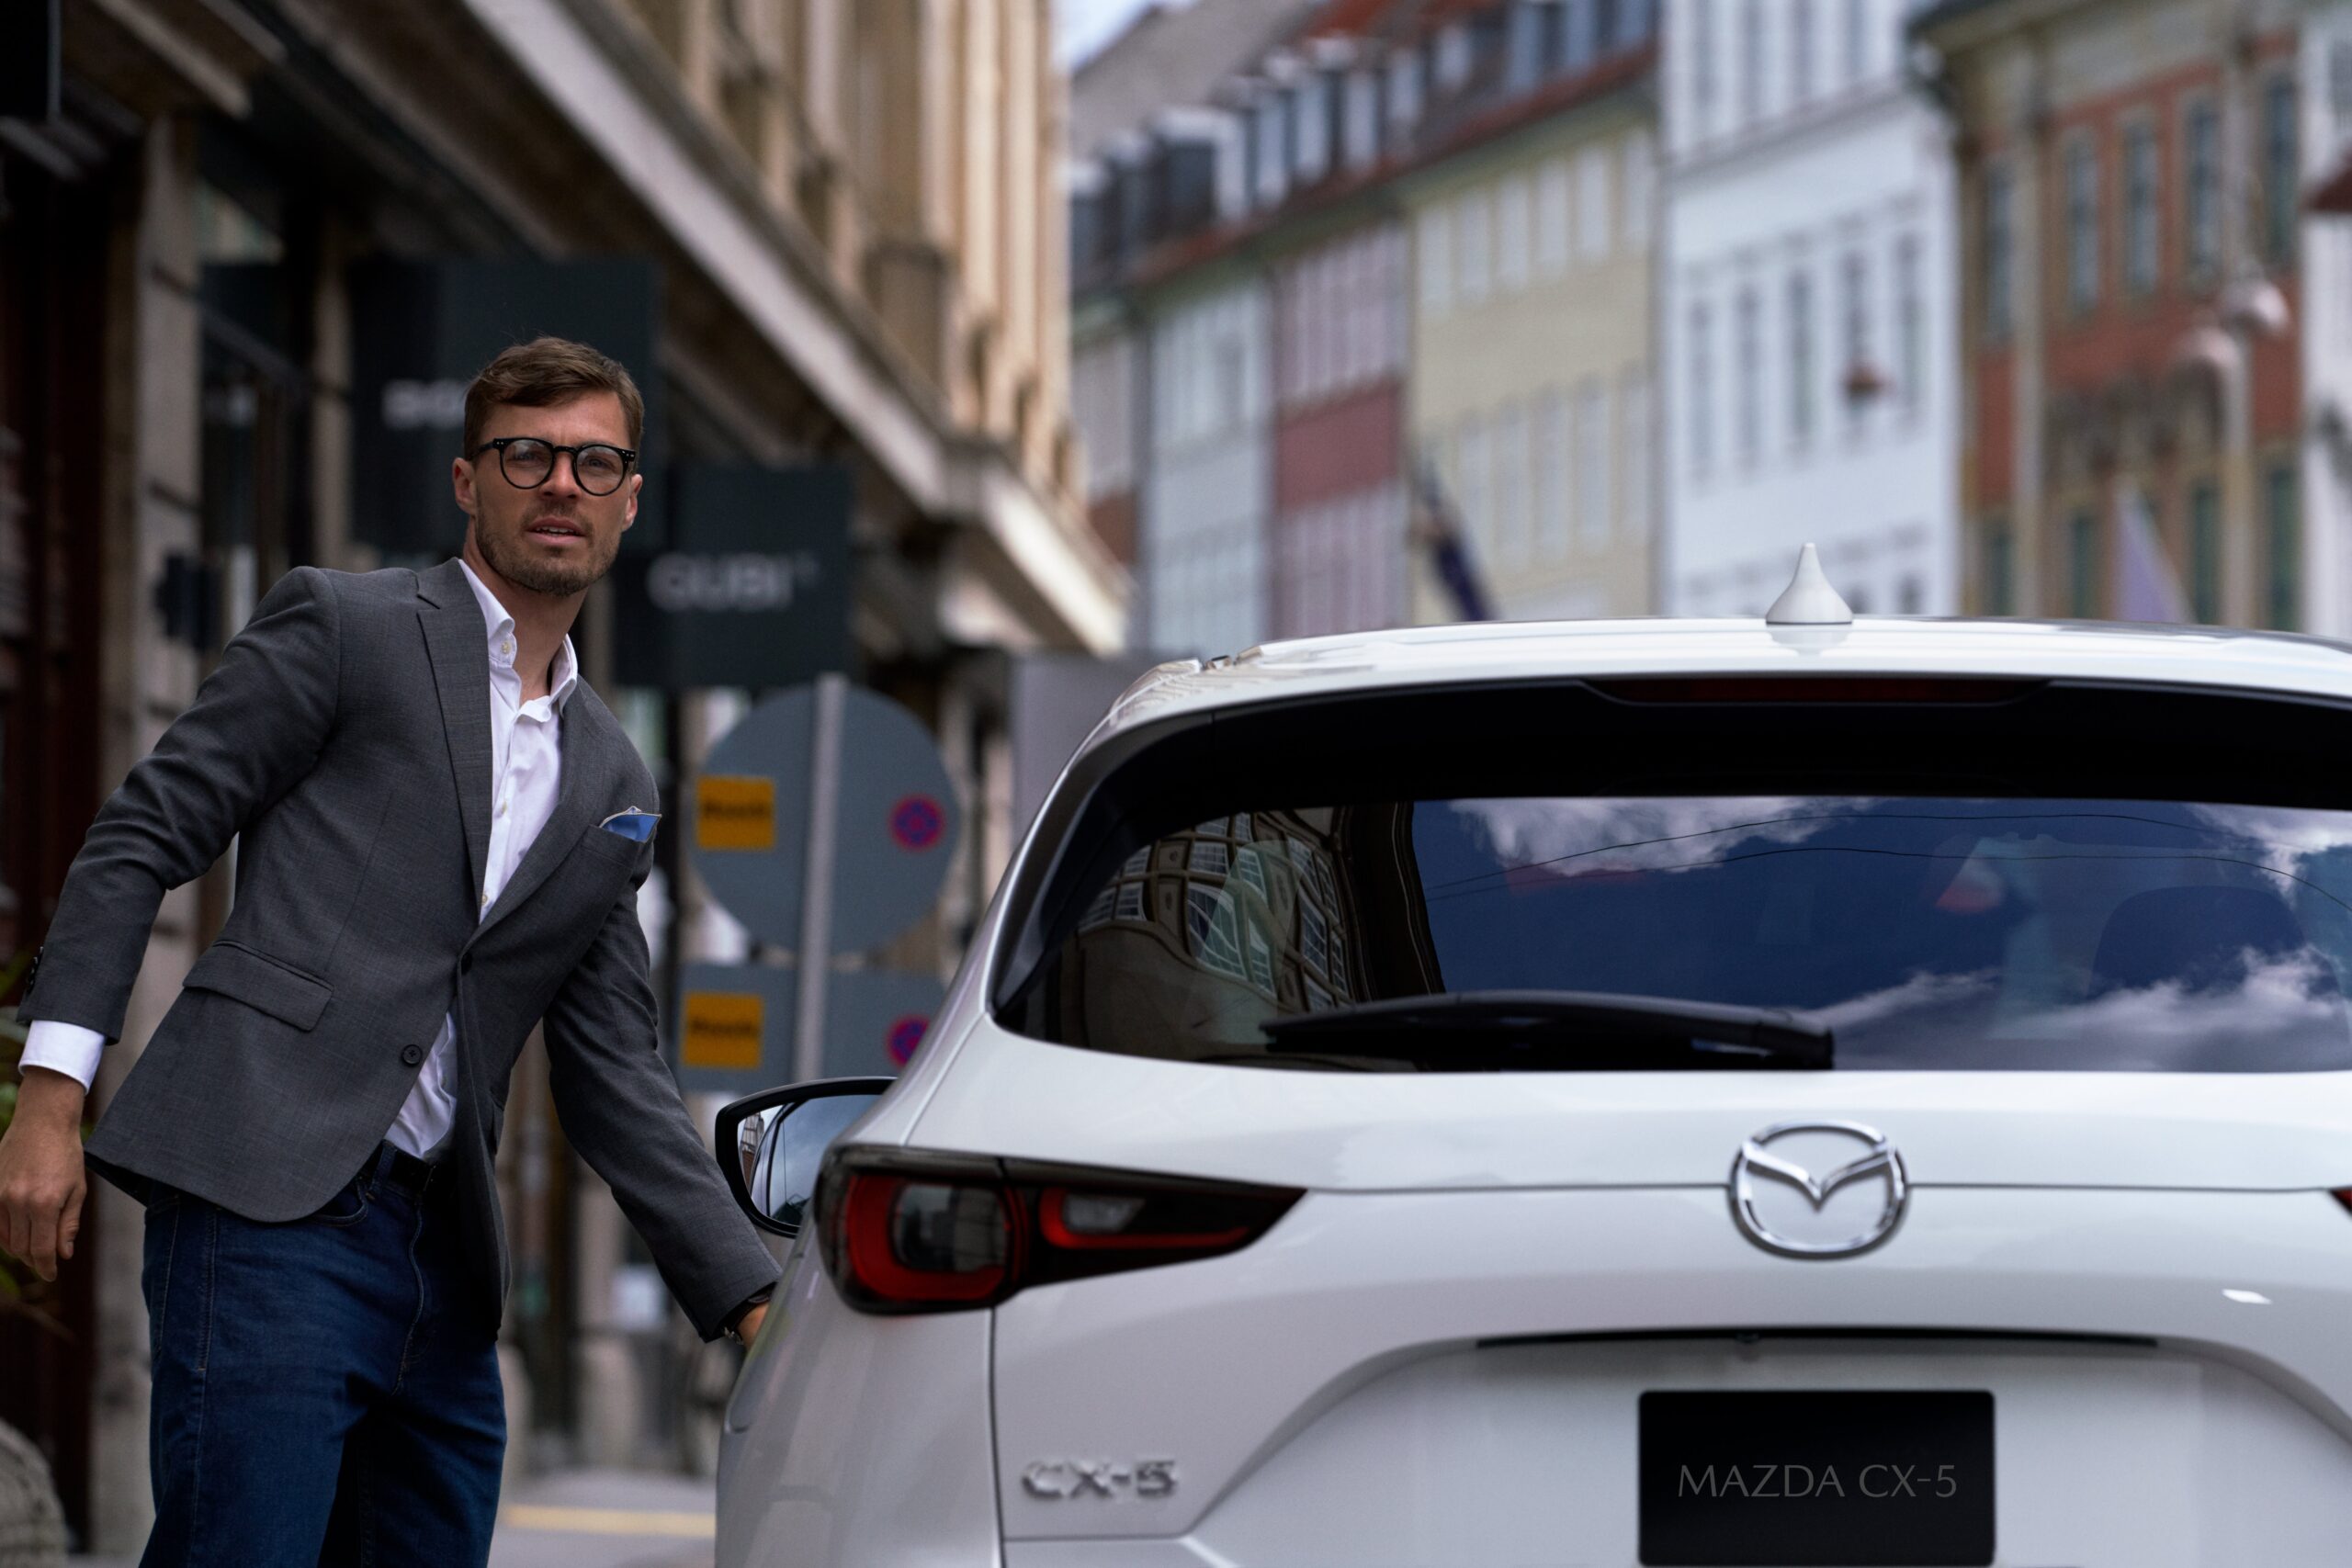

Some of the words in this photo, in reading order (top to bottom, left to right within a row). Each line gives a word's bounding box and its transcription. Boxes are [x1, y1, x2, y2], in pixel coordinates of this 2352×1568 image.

[1021, 1459, 1178, 1500] CX-5
[1678, 1464, 1845, 1497] MAZDA
[1859, 1464, 1957, 1497] CX-5
